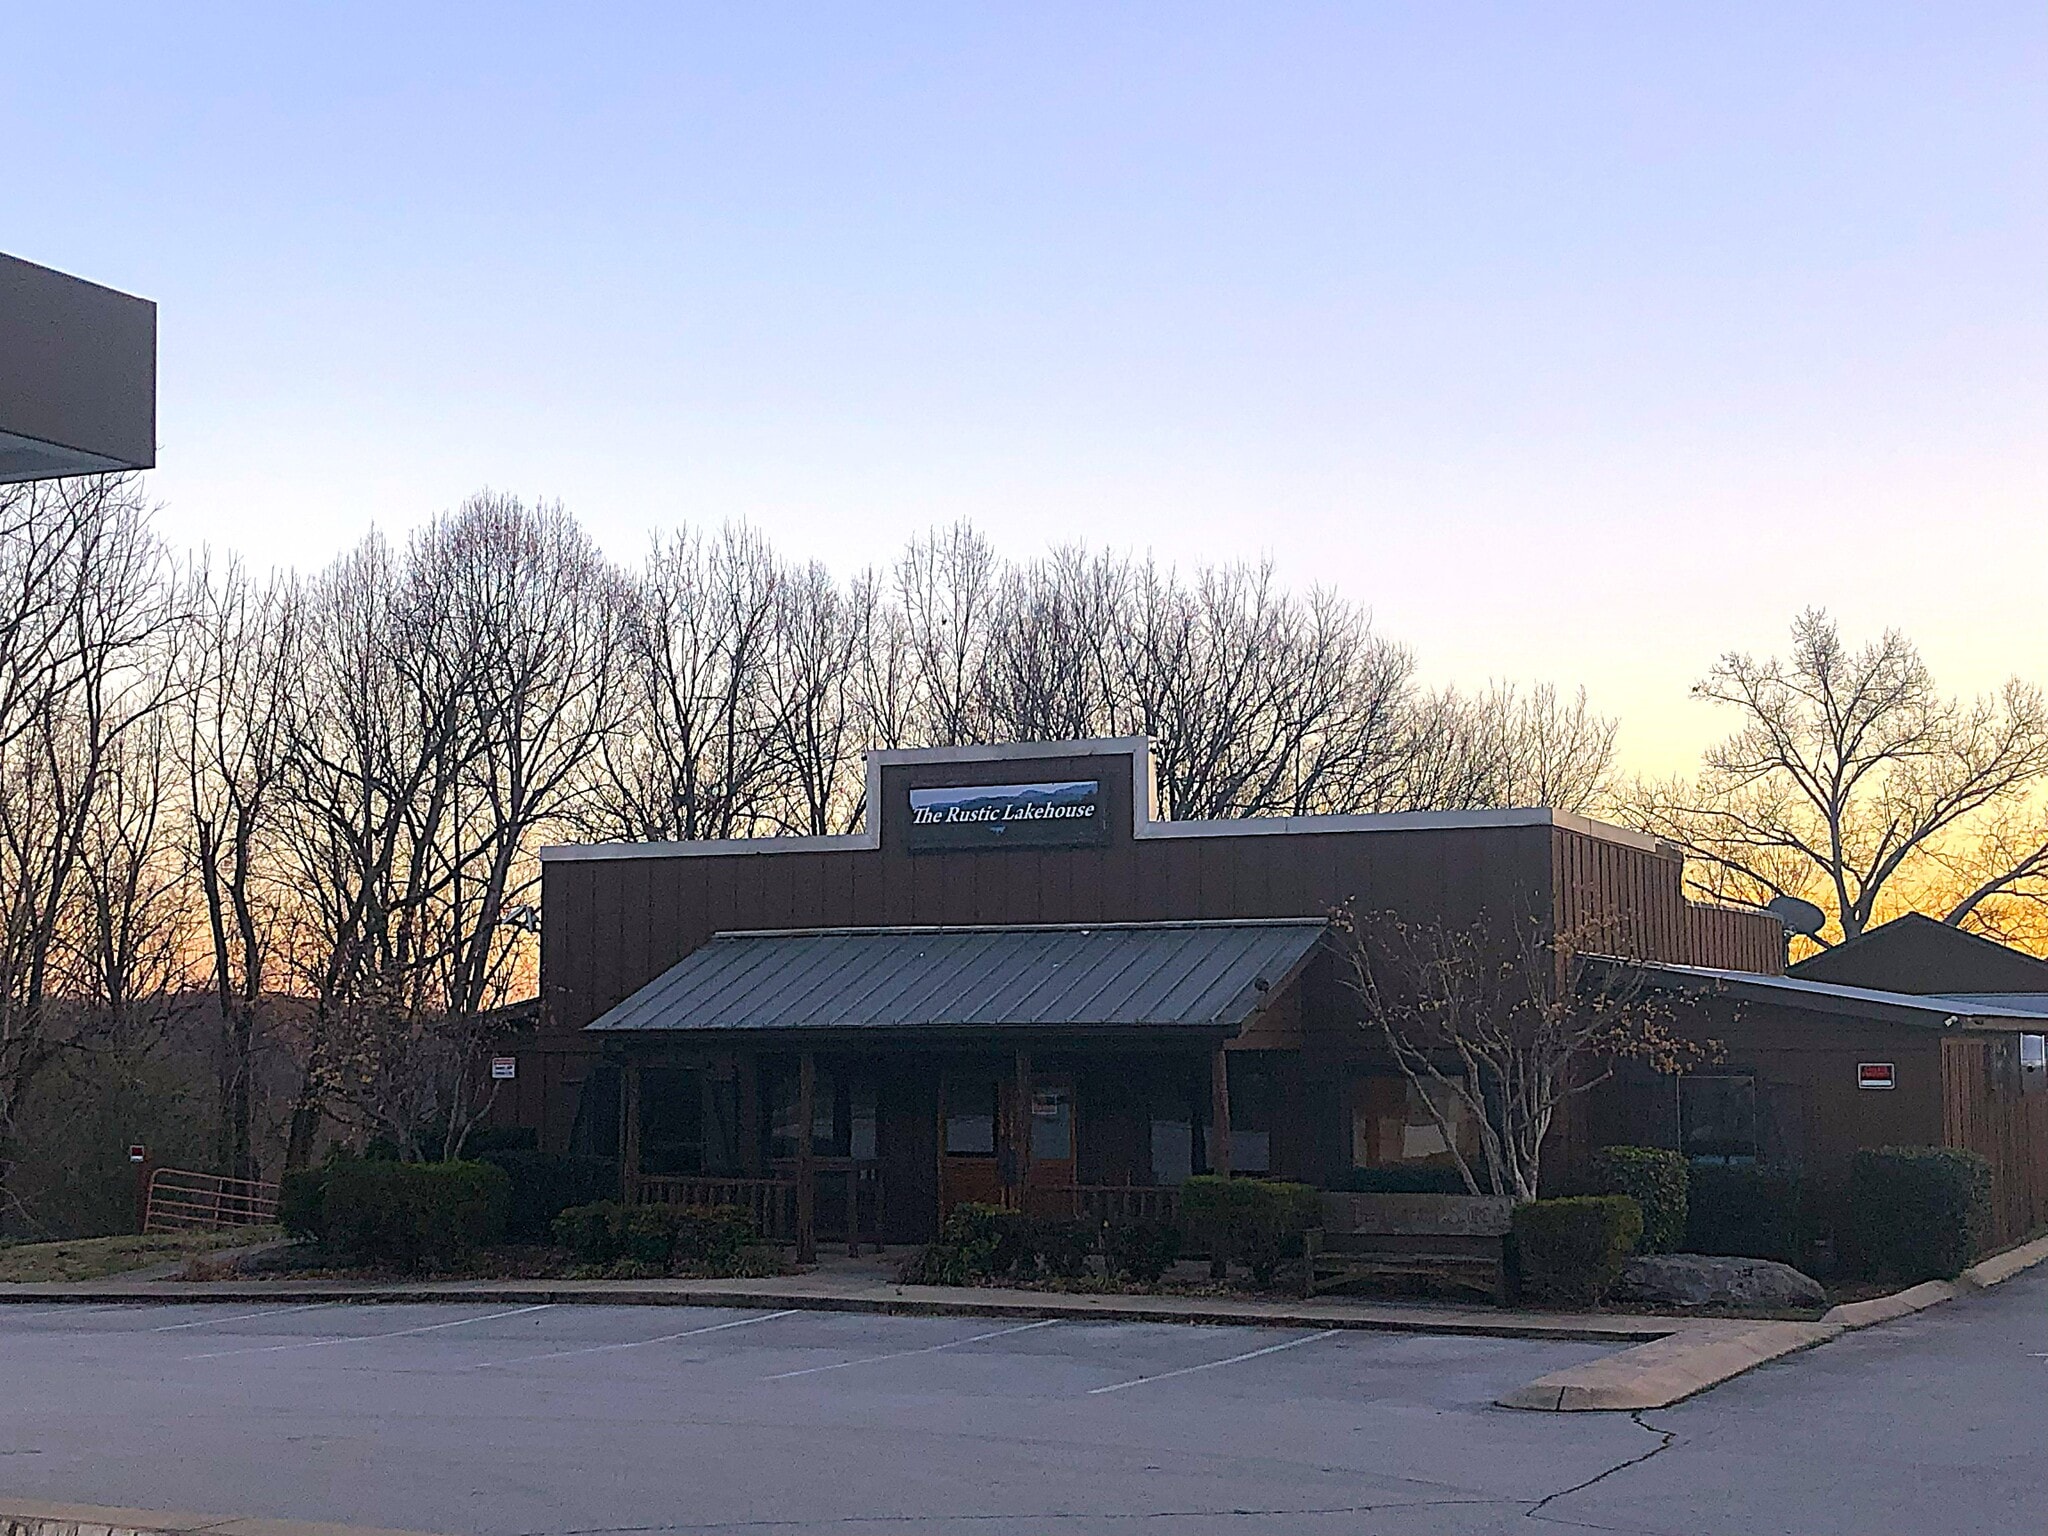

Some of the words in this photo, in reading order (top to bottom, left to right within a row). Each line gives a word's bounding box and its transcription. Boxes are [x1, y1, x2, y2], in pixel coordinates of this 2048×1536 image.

[912, 807, 943, 824] The
[945, 806, 1000, 823] Rustic
[1001, 801, 1095, 821] Lakehouse
